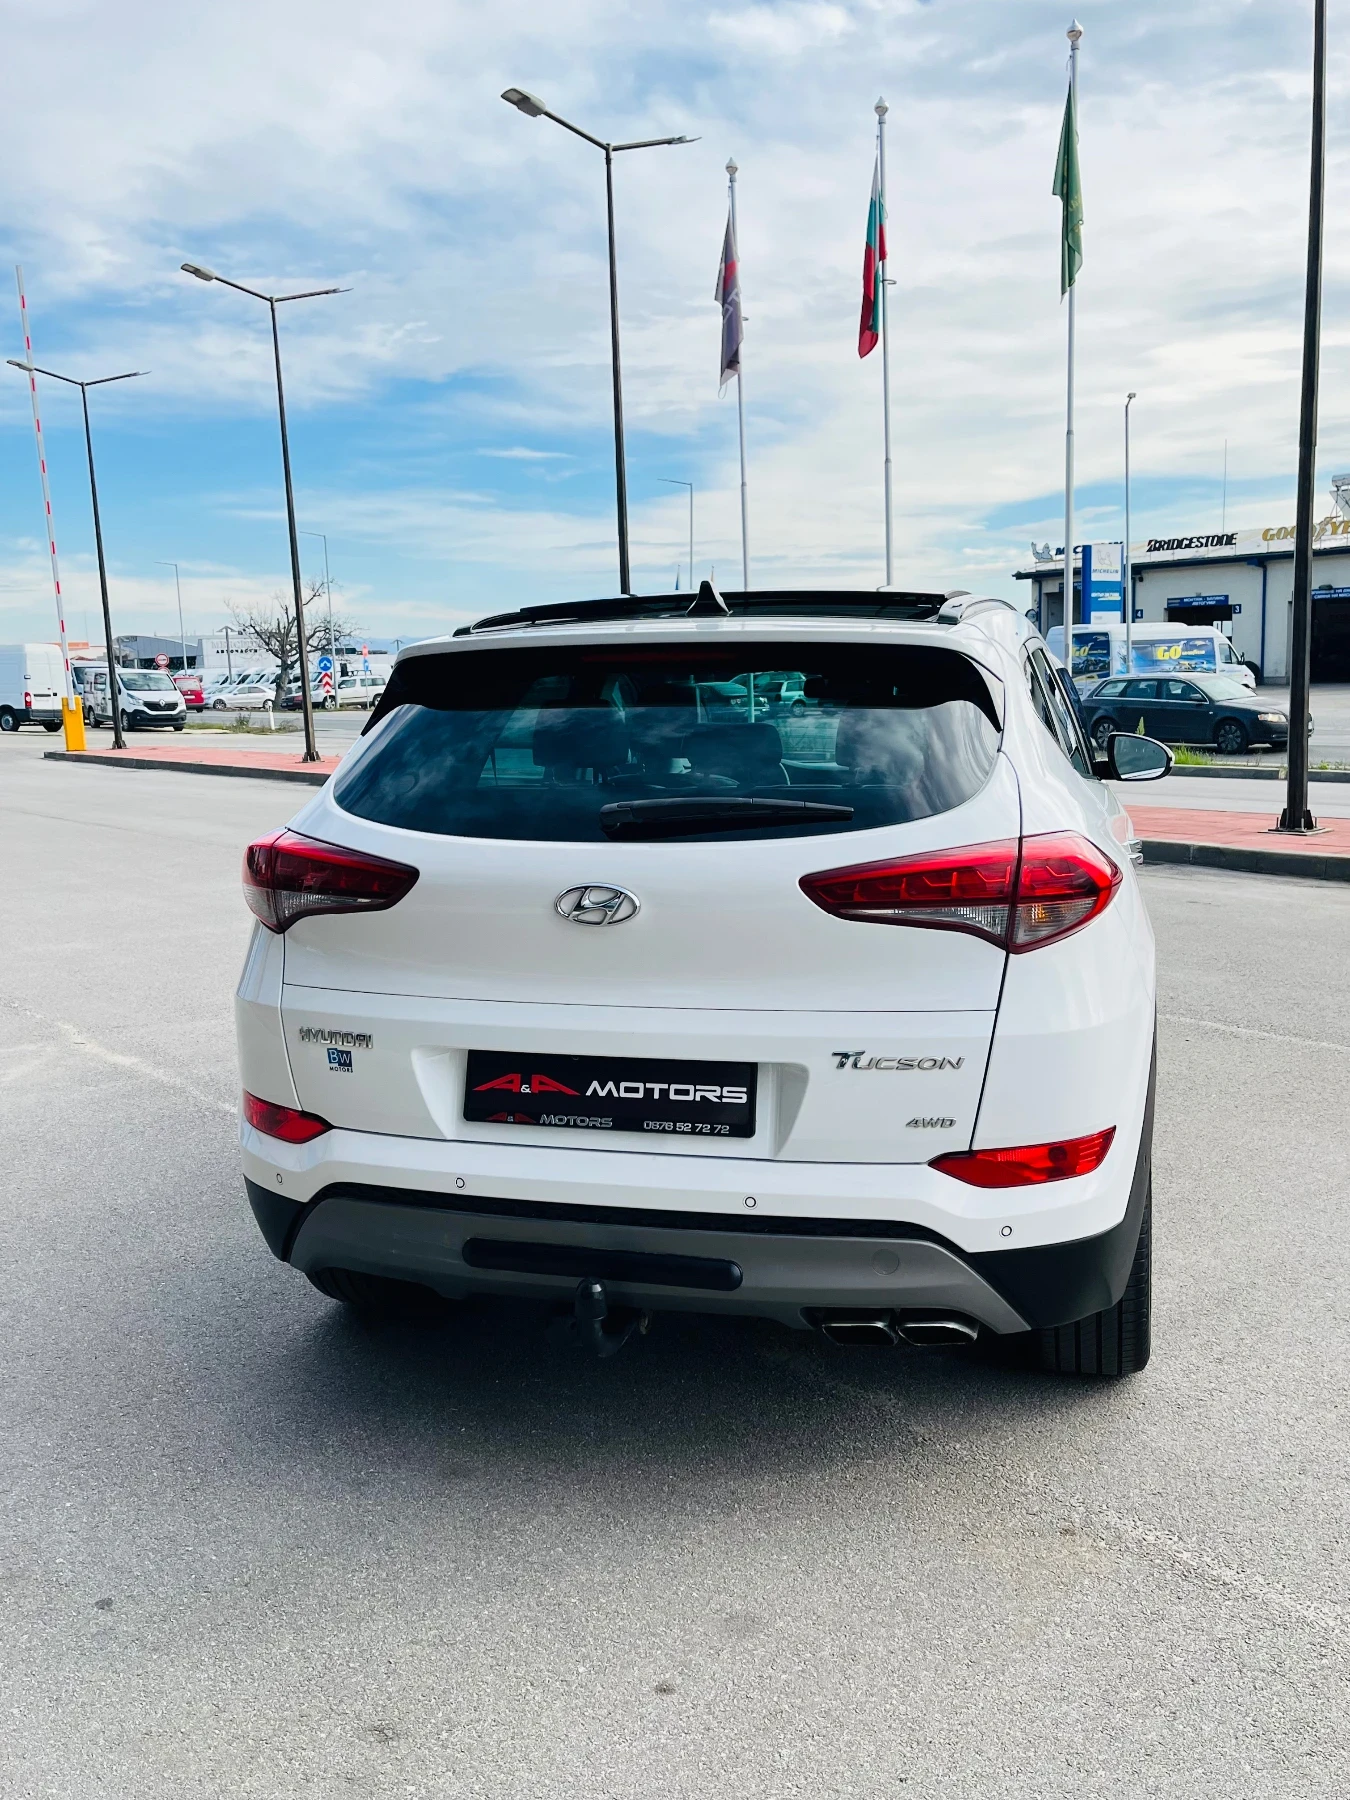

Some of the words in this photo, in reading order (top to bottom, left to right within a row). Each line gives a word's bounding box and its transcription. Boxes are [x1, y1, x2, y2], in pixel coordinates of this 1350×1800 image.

[1146, 533, 1238, 552] BRIDGESTONE
[299, 1026, 373, 1049] HYUNDAI
[328, 1049, 351, 1064] BW
[831, 1050, 966, 1070] TUCSON
[585, 1080, 748, 1104] MOTORS
[539, 1114, 613, 1128] MOTORS
[675, 1122, 692, 1132] 52
[694, 1123, 711, 1134] 72
[713, 1124, 730, 1135] 72
[905, 1116, 957, 1129] 4WD
